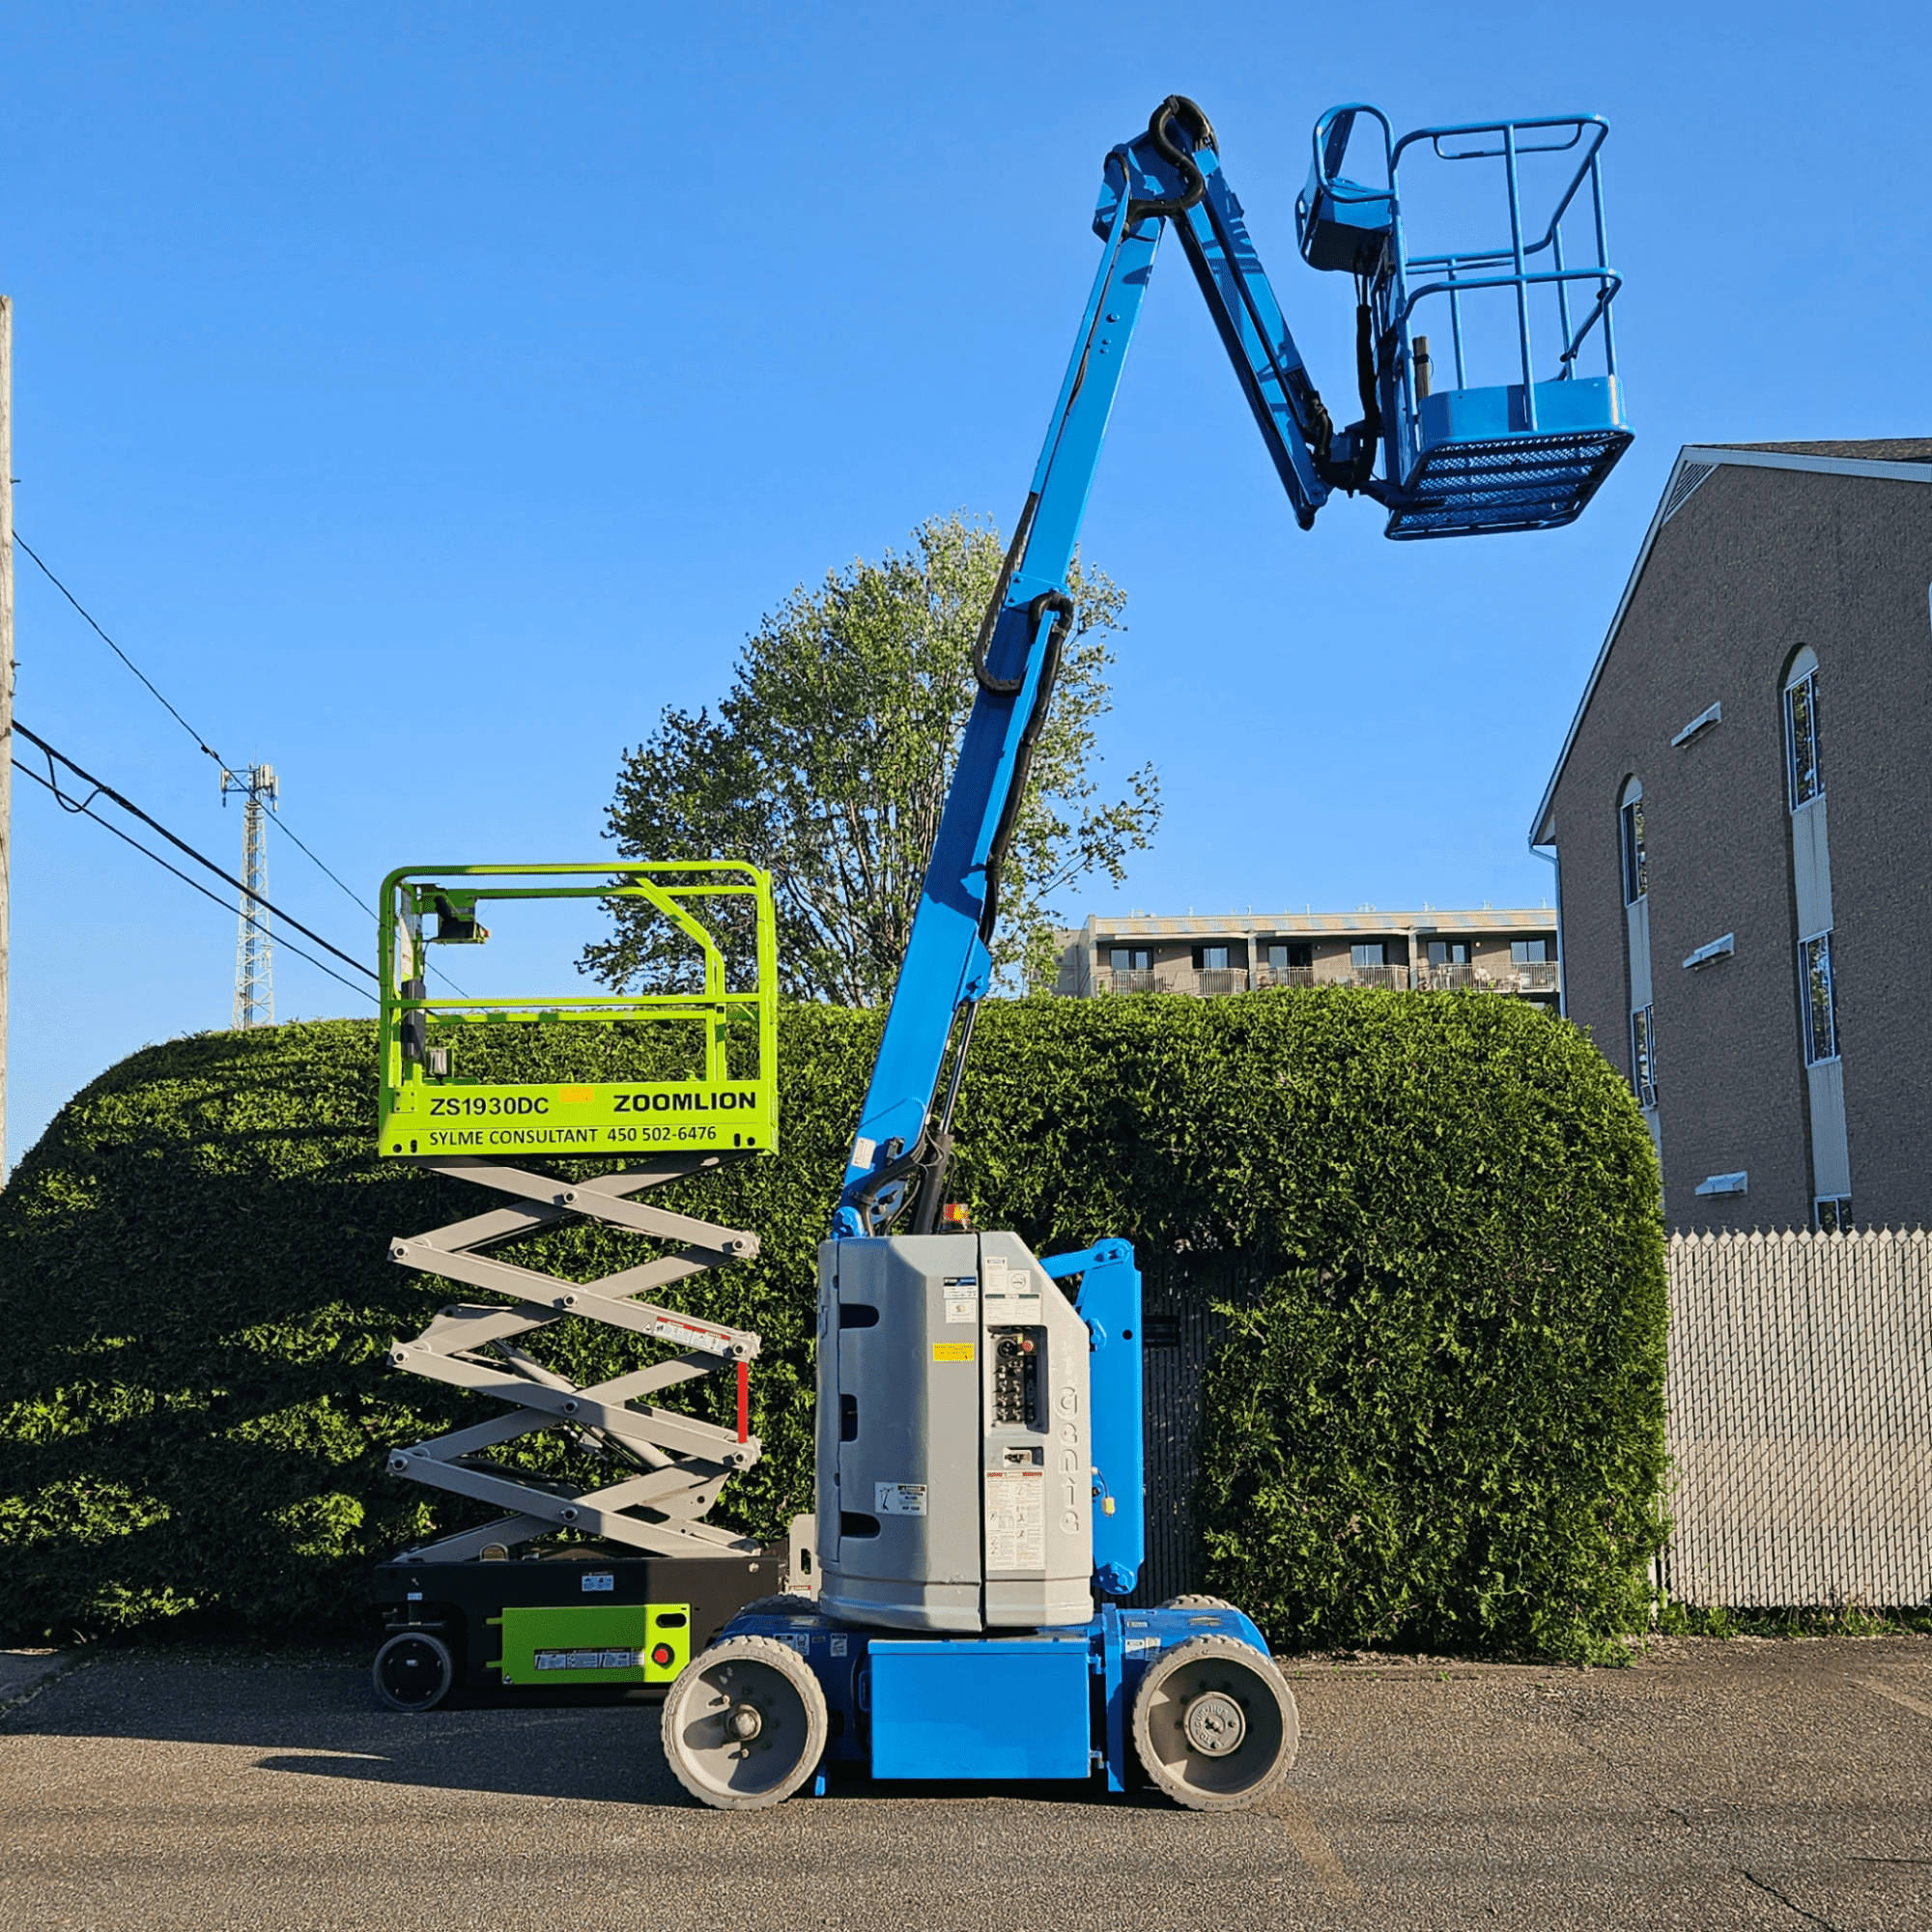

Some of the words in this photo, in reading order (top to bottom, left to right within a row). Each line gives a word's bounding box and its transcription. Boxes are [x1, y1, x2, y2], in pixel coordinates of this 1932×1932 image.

[430, 1096, 549, 1116] ZS1930DC
[613, 1092, 756, 1113] ZOOMLION
[429, 1131, 484, 1146] SYLME
[489, 1128, 599, 1145] CONSULTANT
[607, 1127, 637, 1142] 450
[642, 1125, 717, 1142] 502-6476
[1055, 1385, 1079, 1534] Genie
